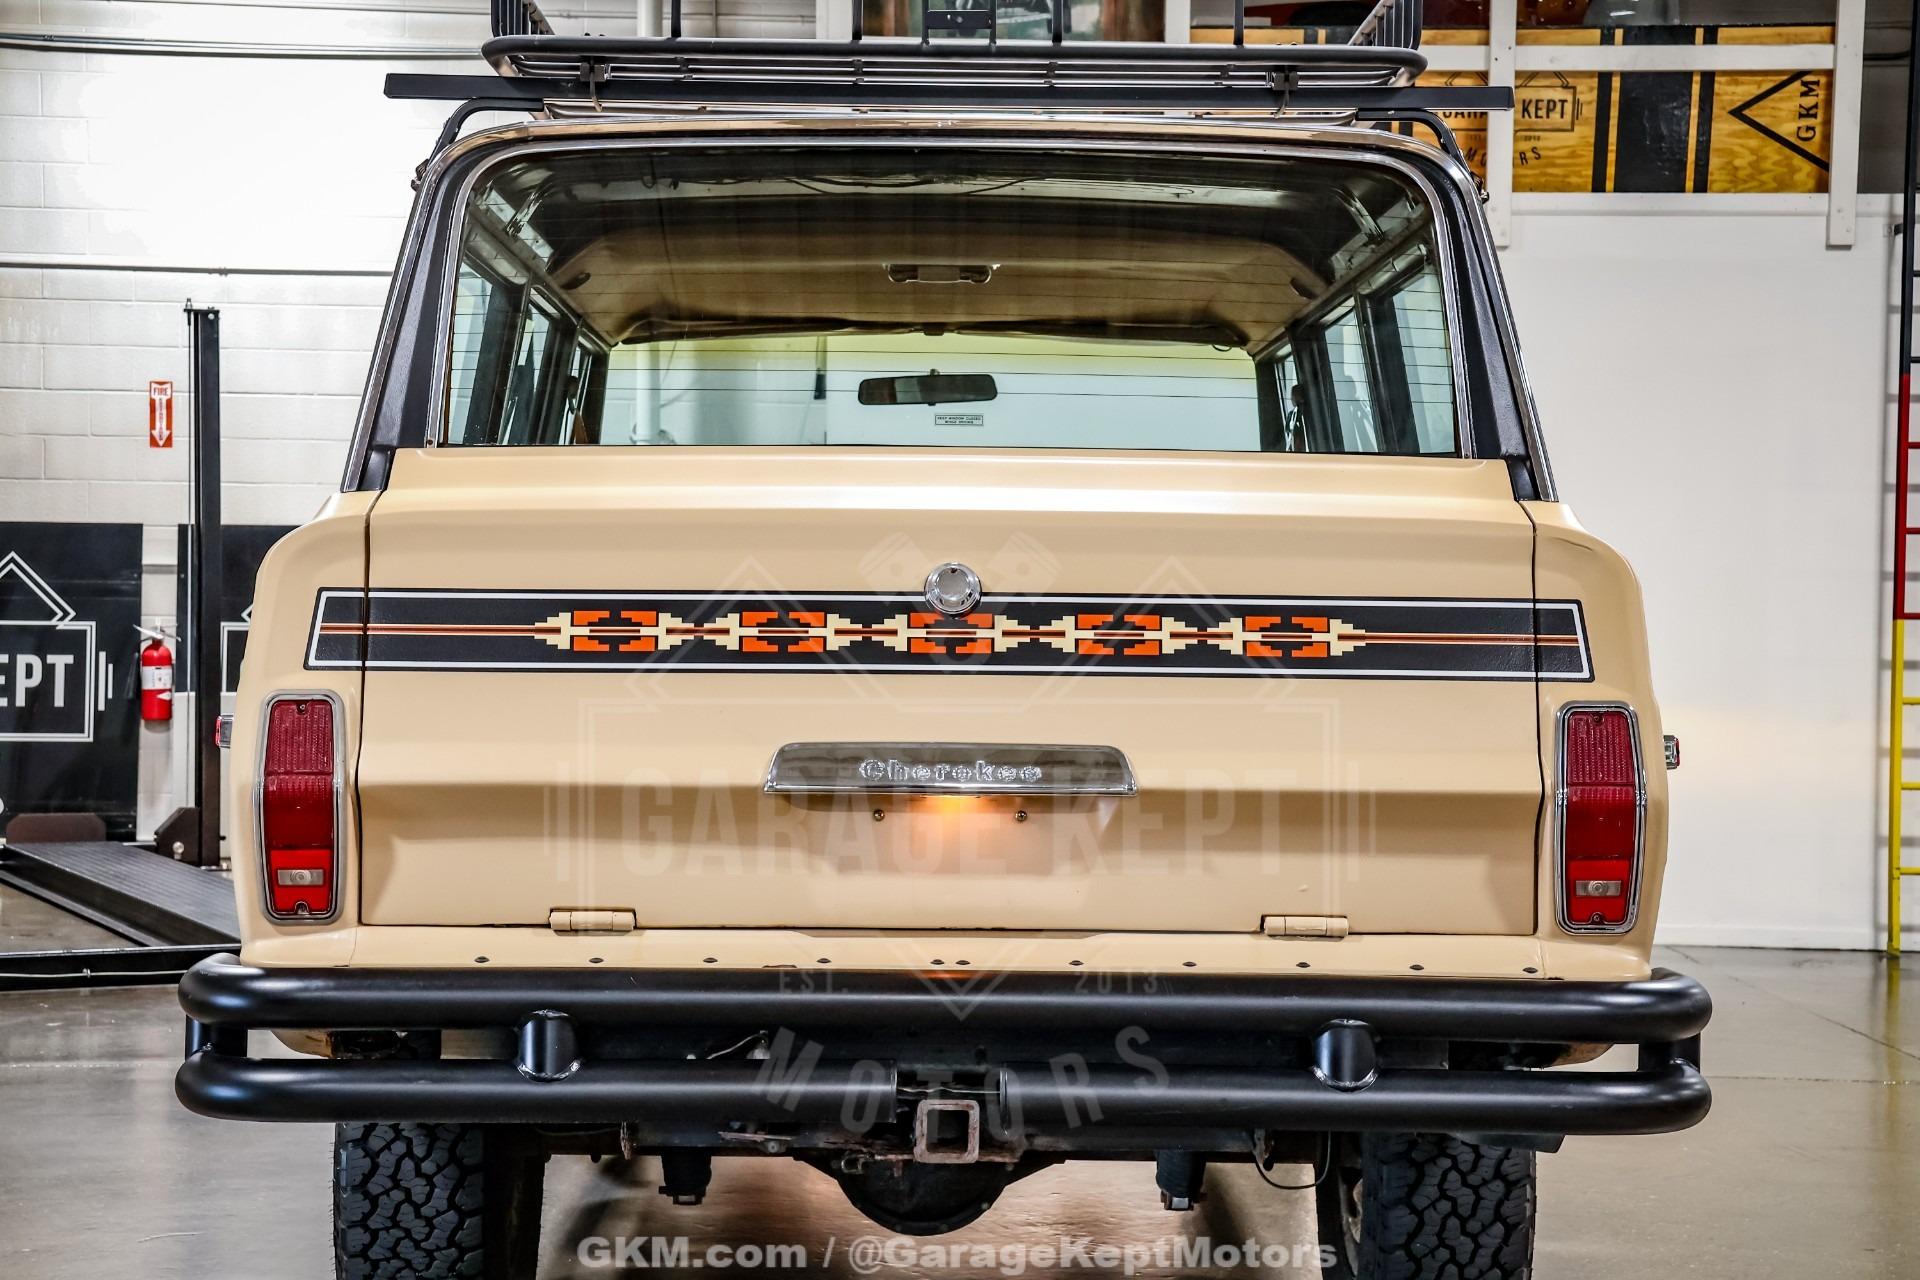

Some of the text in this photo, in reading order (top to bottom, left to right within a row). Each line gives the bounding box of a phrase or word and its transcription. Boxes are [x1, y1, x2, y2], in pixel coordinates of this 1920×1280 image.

[1521, 99, 1569, 119] KEPT
[1796, 79, 1820, 142] GKM
[153, 386, 169, 396] FIRE
[859, 759, 1043, 783] Cherokee
